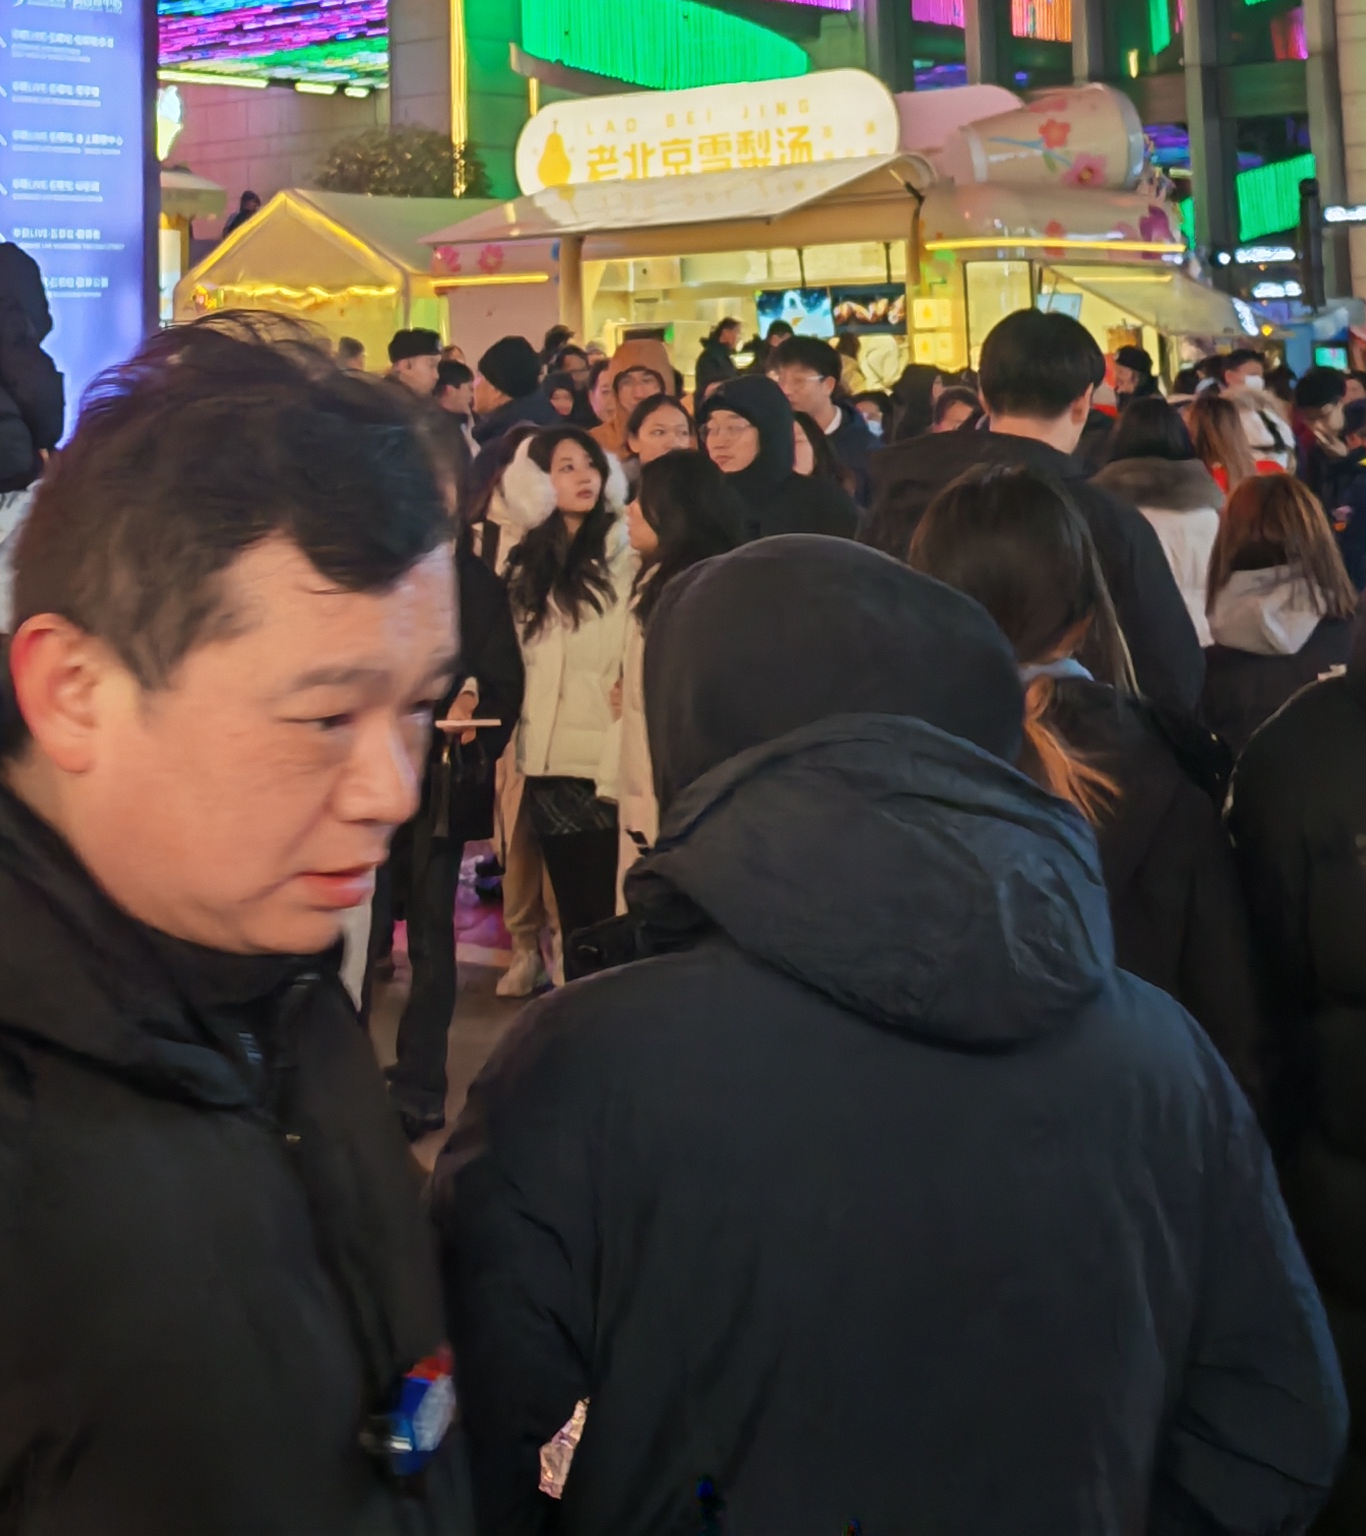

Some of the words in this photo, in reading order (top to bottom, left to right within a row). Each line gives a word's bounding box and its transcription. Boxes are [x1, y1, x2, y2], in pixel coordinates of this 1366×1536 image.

[586, 119, 637, 136] LAO
[666, 108, 713, 128] BEI
[742, 98, 811, 121] JING
[586, 125, 815, 182] 老北京雪梨汤
